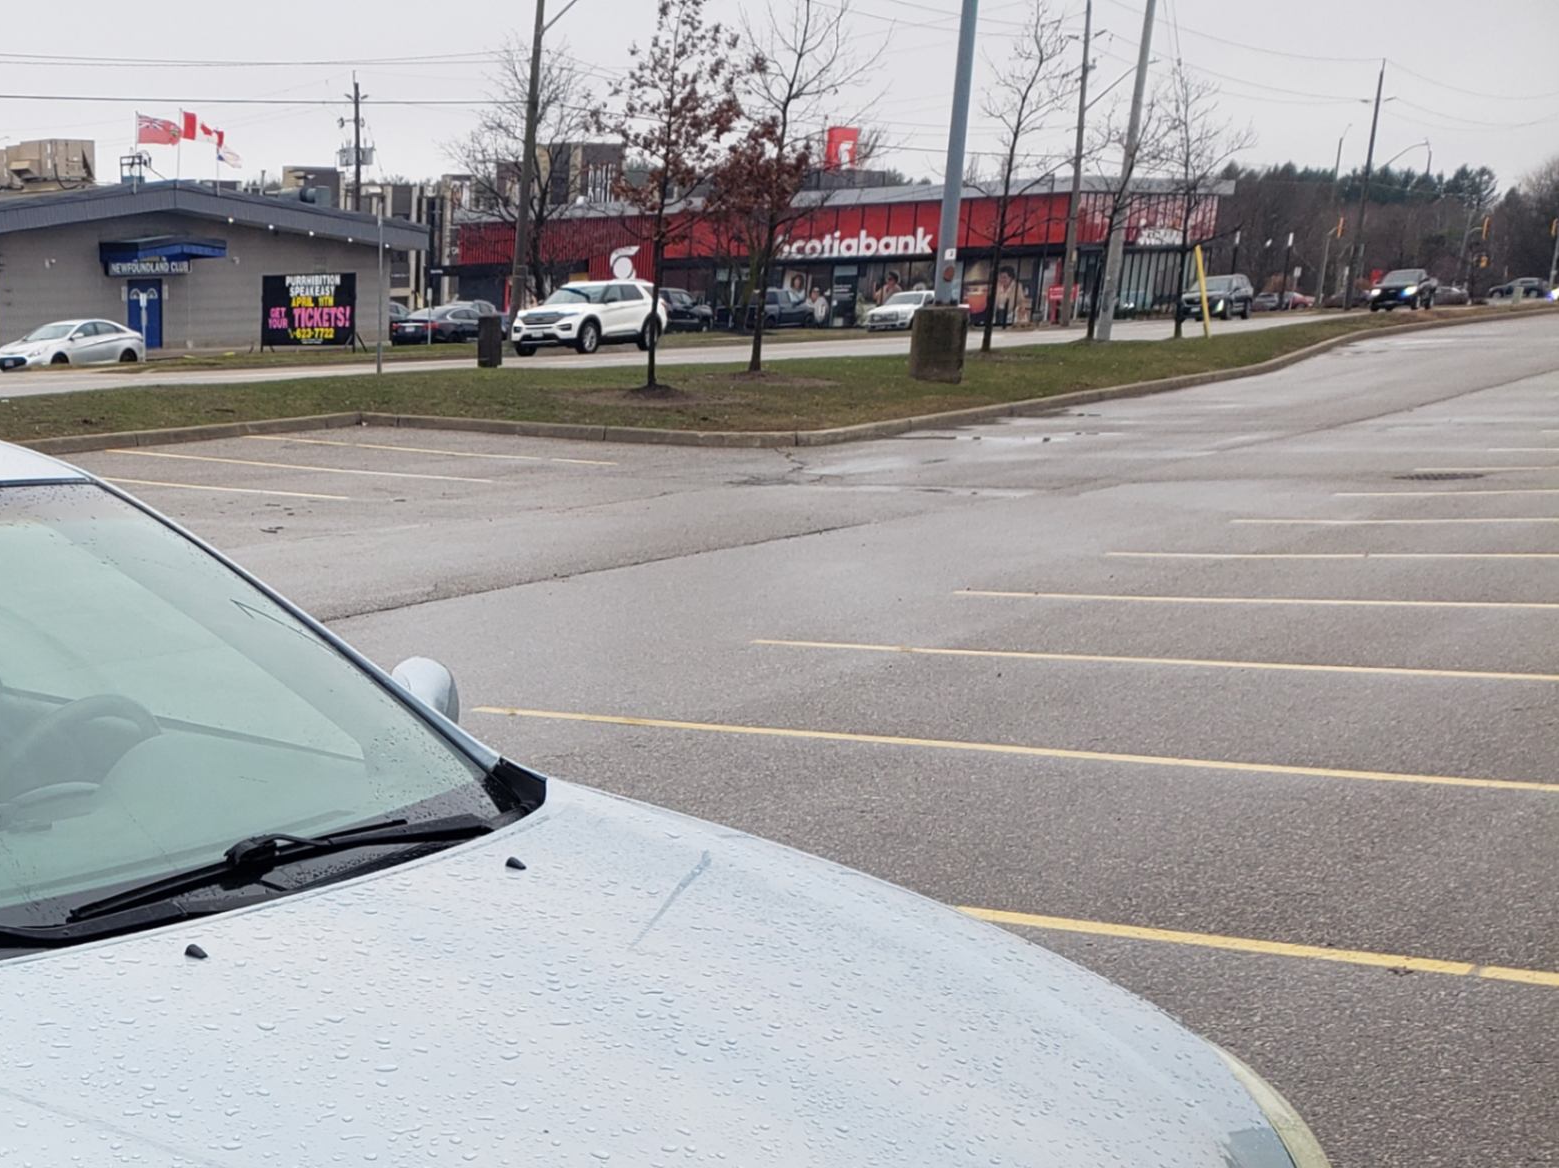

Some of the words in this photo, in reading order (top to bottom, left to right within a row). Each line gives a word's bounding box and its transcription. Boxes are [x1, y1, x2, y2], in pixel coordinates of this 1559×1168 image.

[111, 261, 170, 273] NEWFOUNDLAND
[170, 261, 189, 272] CLUB
[285, 274, 341, 287] PURRHIBITION
[289, 286, 335, 296] SPEAKEASY
[291, 296, 315, 307] APRIL
[270, 307, 286, 318] GET
[293, 306, 351, 327] TICKETS!
[268, 318, 288, 328] YOUR
